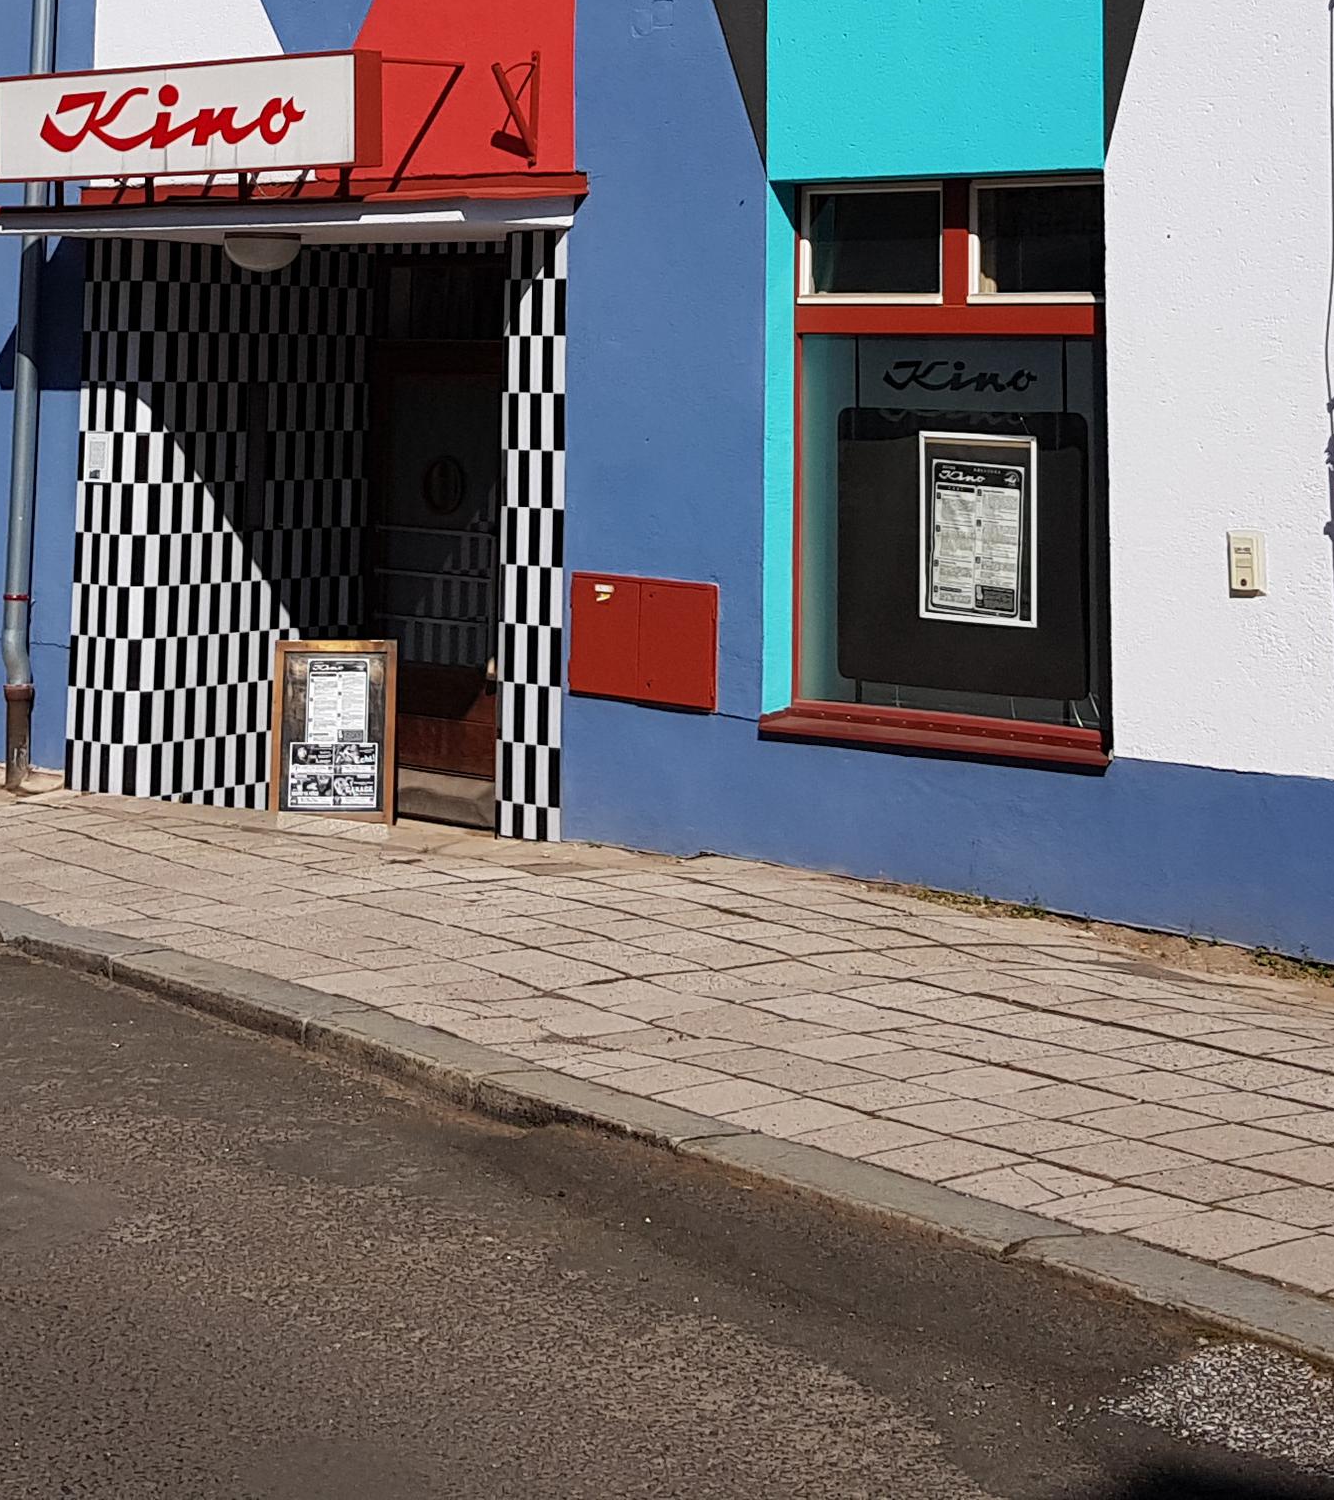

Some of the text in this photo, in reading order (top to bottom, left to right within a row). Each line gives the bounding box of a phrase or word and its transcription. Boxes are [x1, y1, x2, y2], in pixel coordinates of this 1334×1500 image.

[40, 84, 306, 152] Kino
[883, 361, 1037, 392] Kino
[939, 470, 986, 483] Kino
